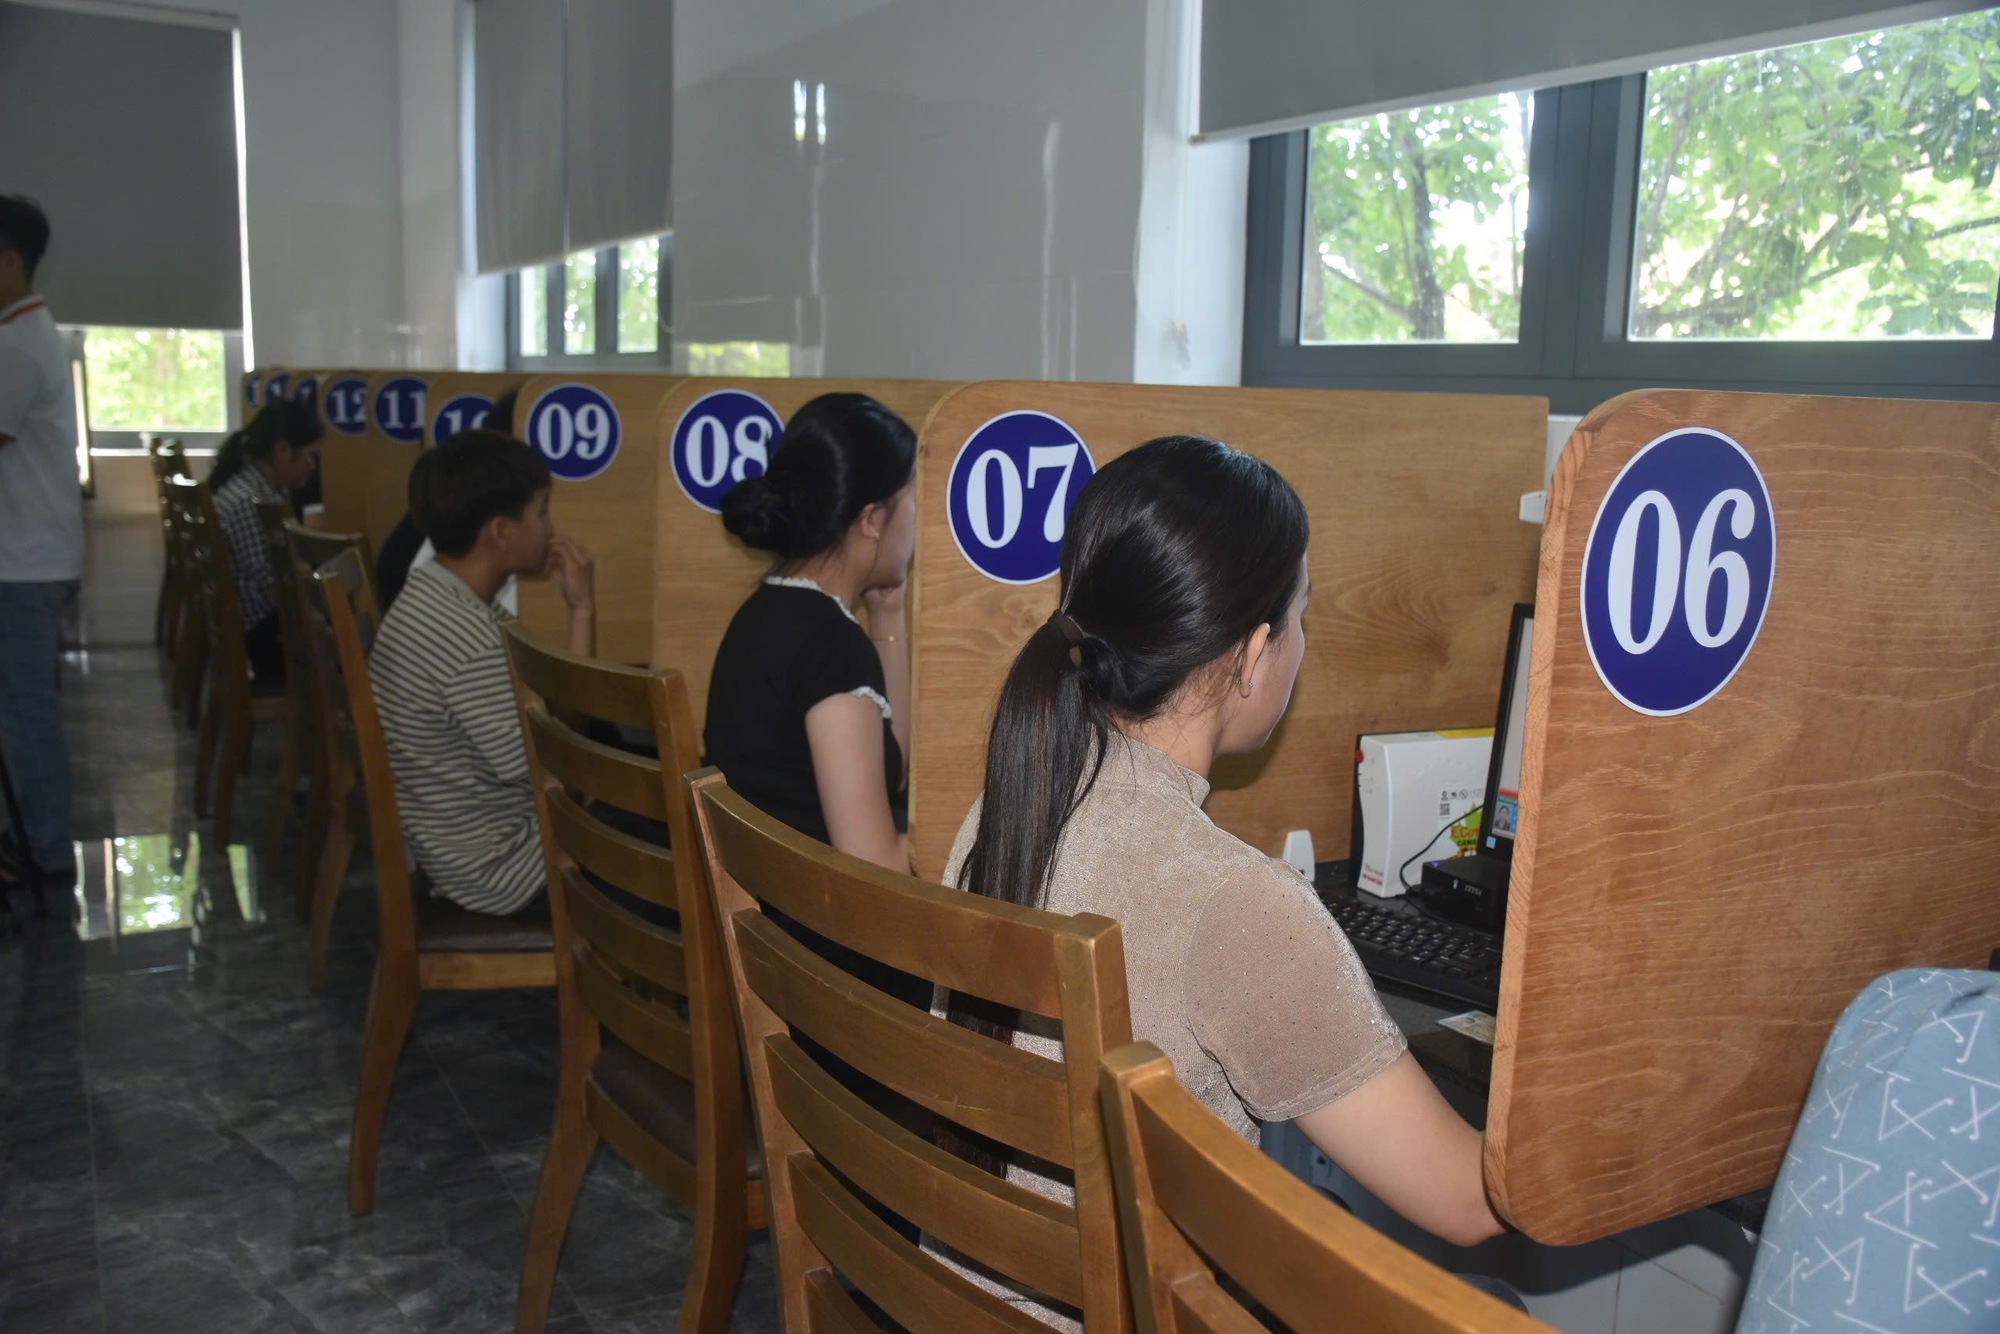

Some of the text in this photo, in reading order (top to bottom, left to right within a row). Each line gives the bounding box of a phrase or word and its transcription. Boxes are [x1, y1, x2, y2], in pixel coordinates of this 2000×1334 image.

[331, 388, 367, 424] 12
[383, 389, 426, 429] 11
[537, 402, 611, 461] 09
[685, 414, 773, 488] 08
[966, 442, 1079, 549] 07
[1607, 488, 1755, 655] 06
